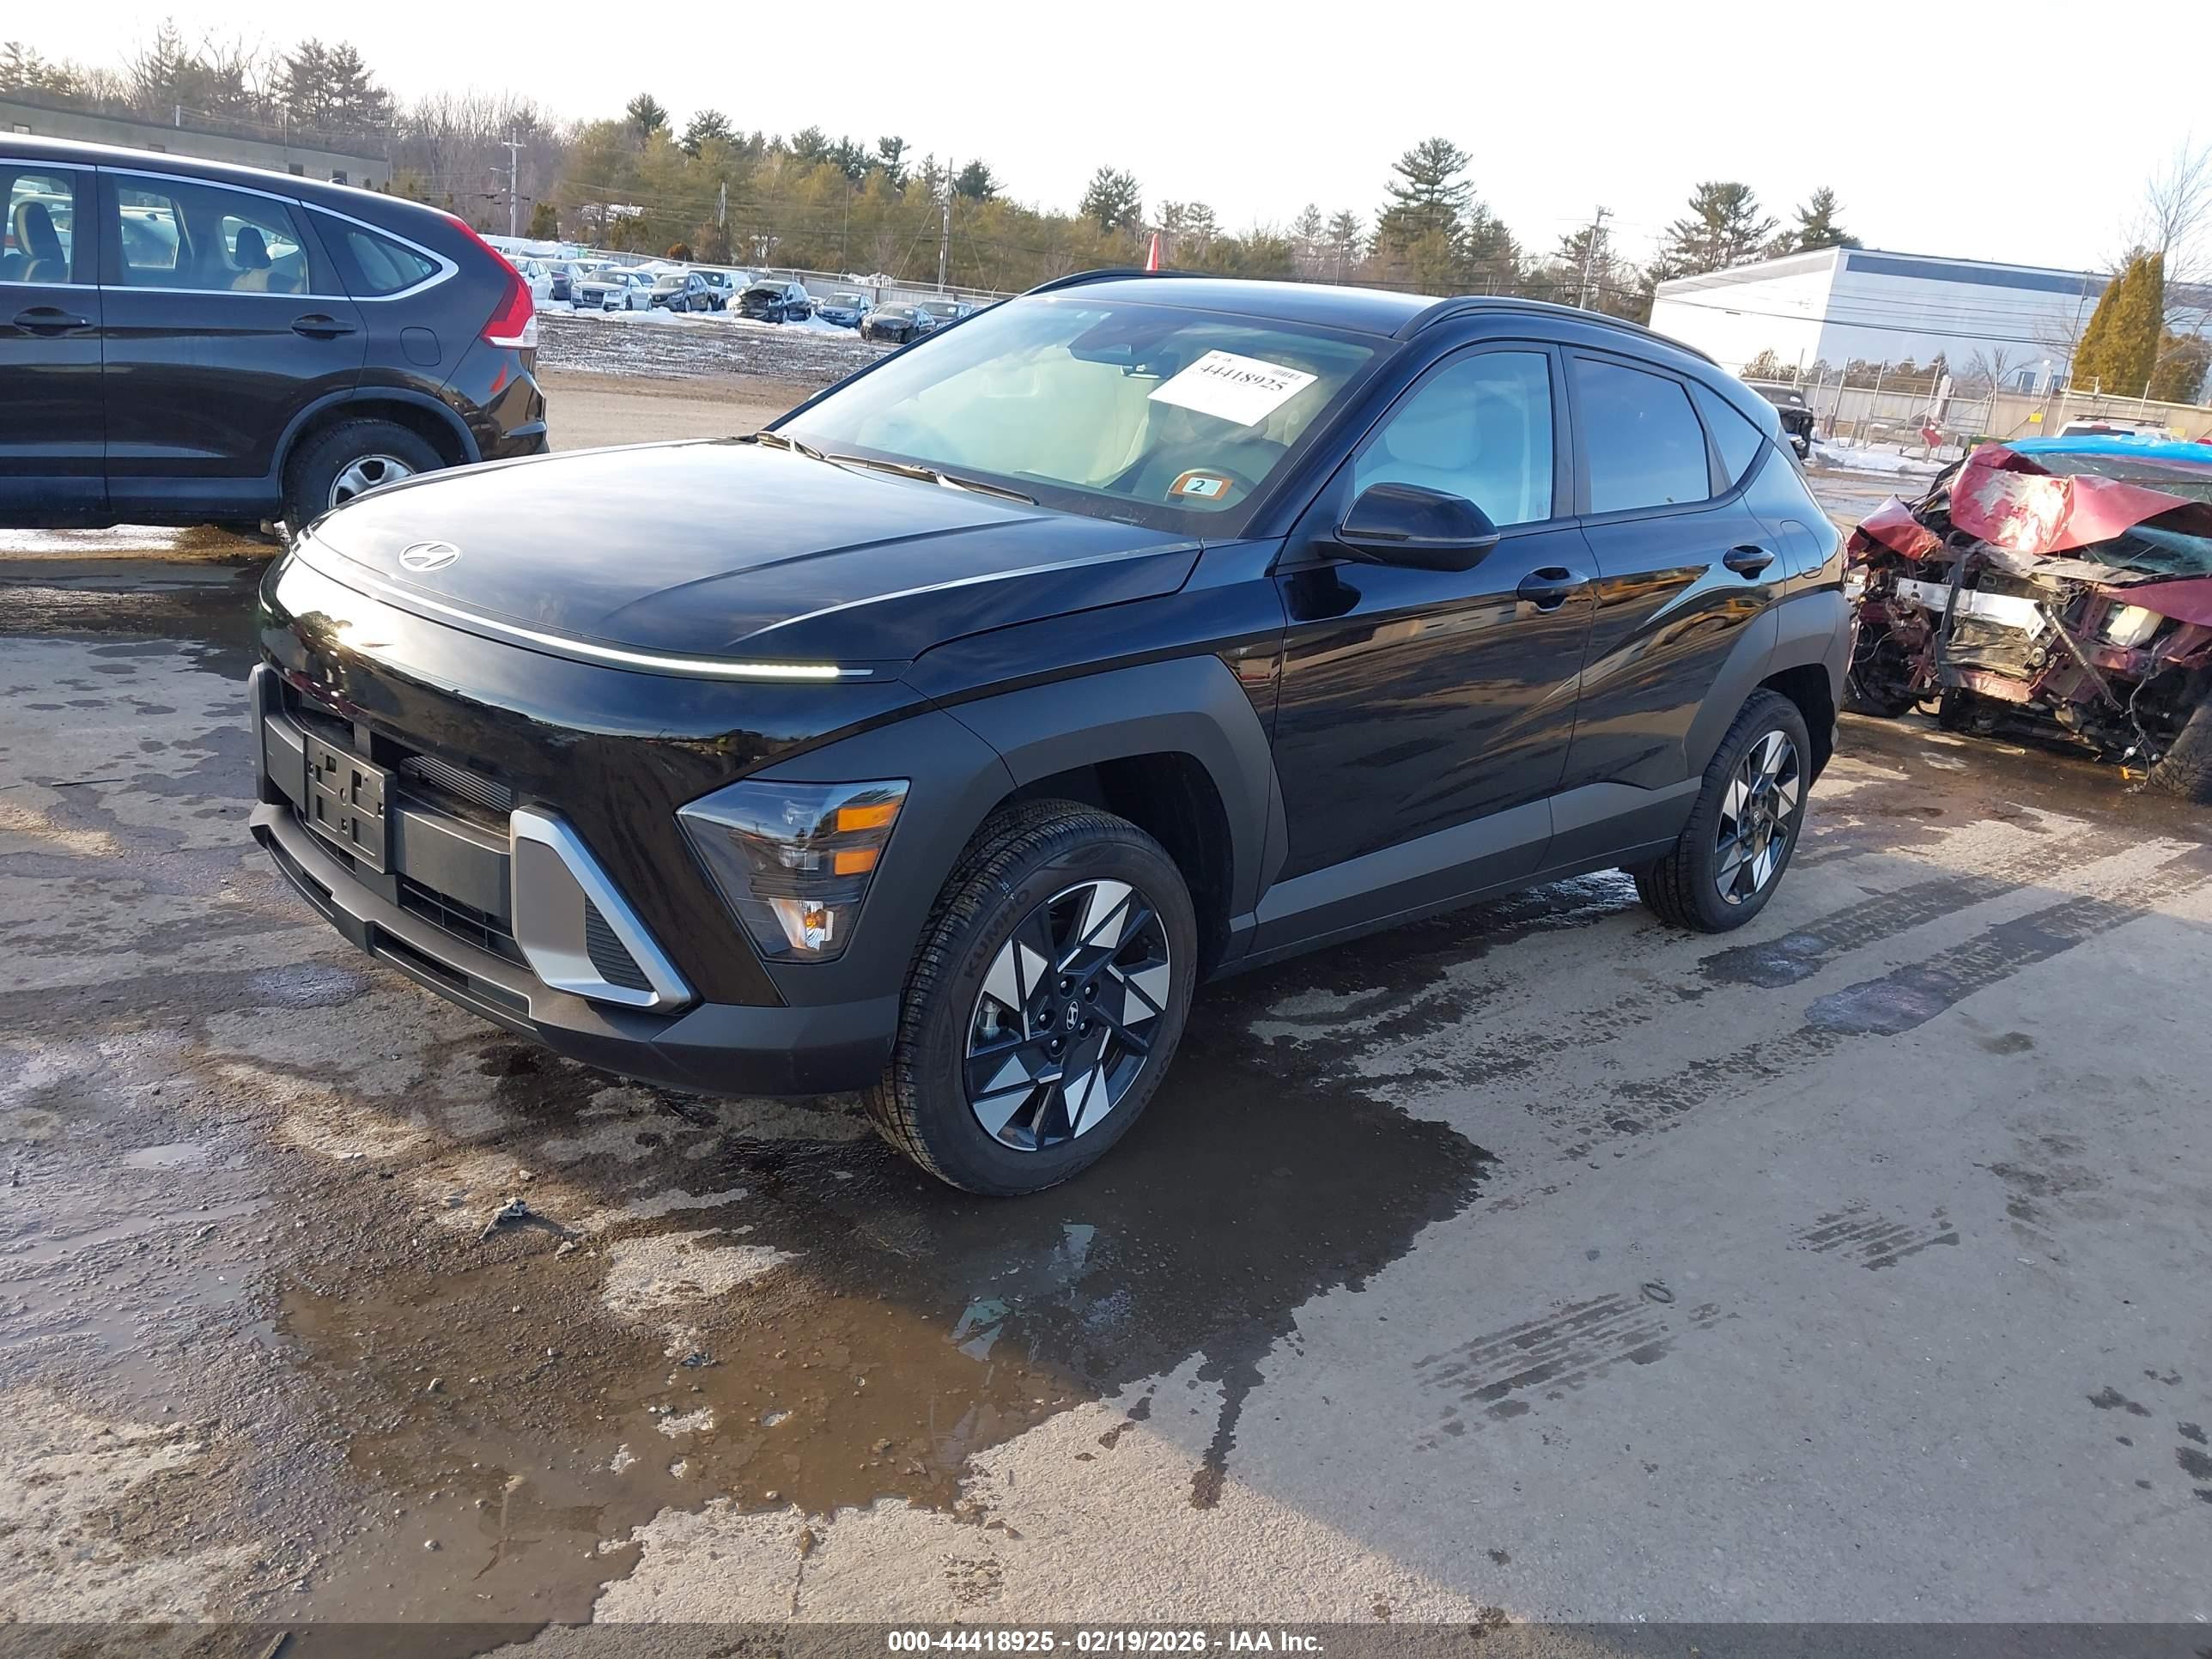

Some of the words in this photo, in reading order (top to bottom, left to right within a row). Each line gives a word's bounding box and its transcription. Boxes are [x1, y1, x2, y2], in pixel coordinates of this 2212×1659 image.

[1200, 363, 1290, 392] 44418925
[1190, 479, 1206, 492] 2
[963, 888, 1031, 979] KUMHO
